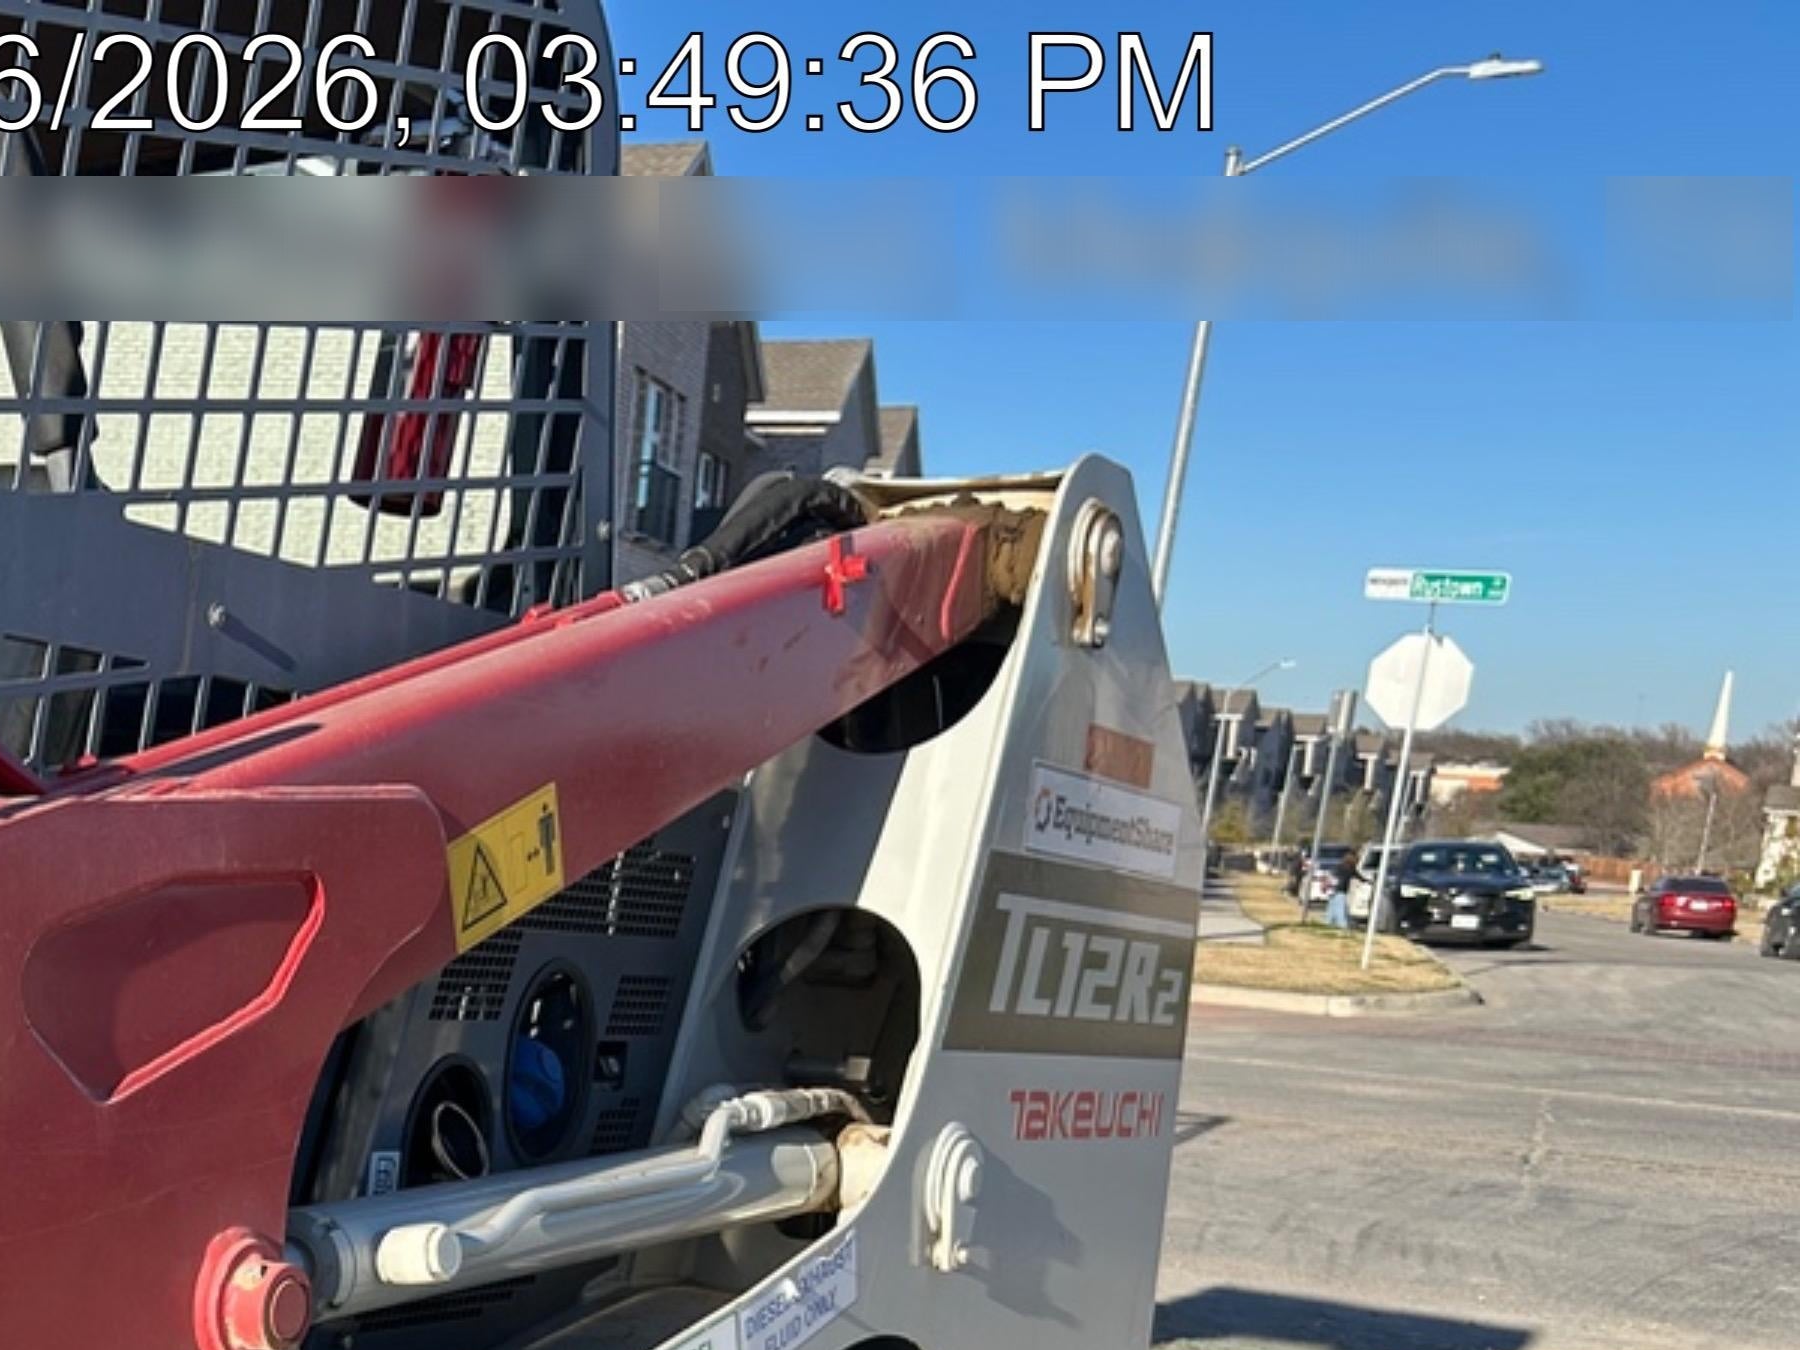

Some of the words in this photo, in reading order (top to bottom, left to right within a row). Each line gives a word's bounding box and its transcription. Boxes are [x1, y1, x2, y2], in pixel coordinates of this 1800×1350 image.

[1052, 795, 1175, 855] EquipmentShare
[989, 893, 1196, 1026] TL12R2
[804, 1286, 838, 1327] ONLY
